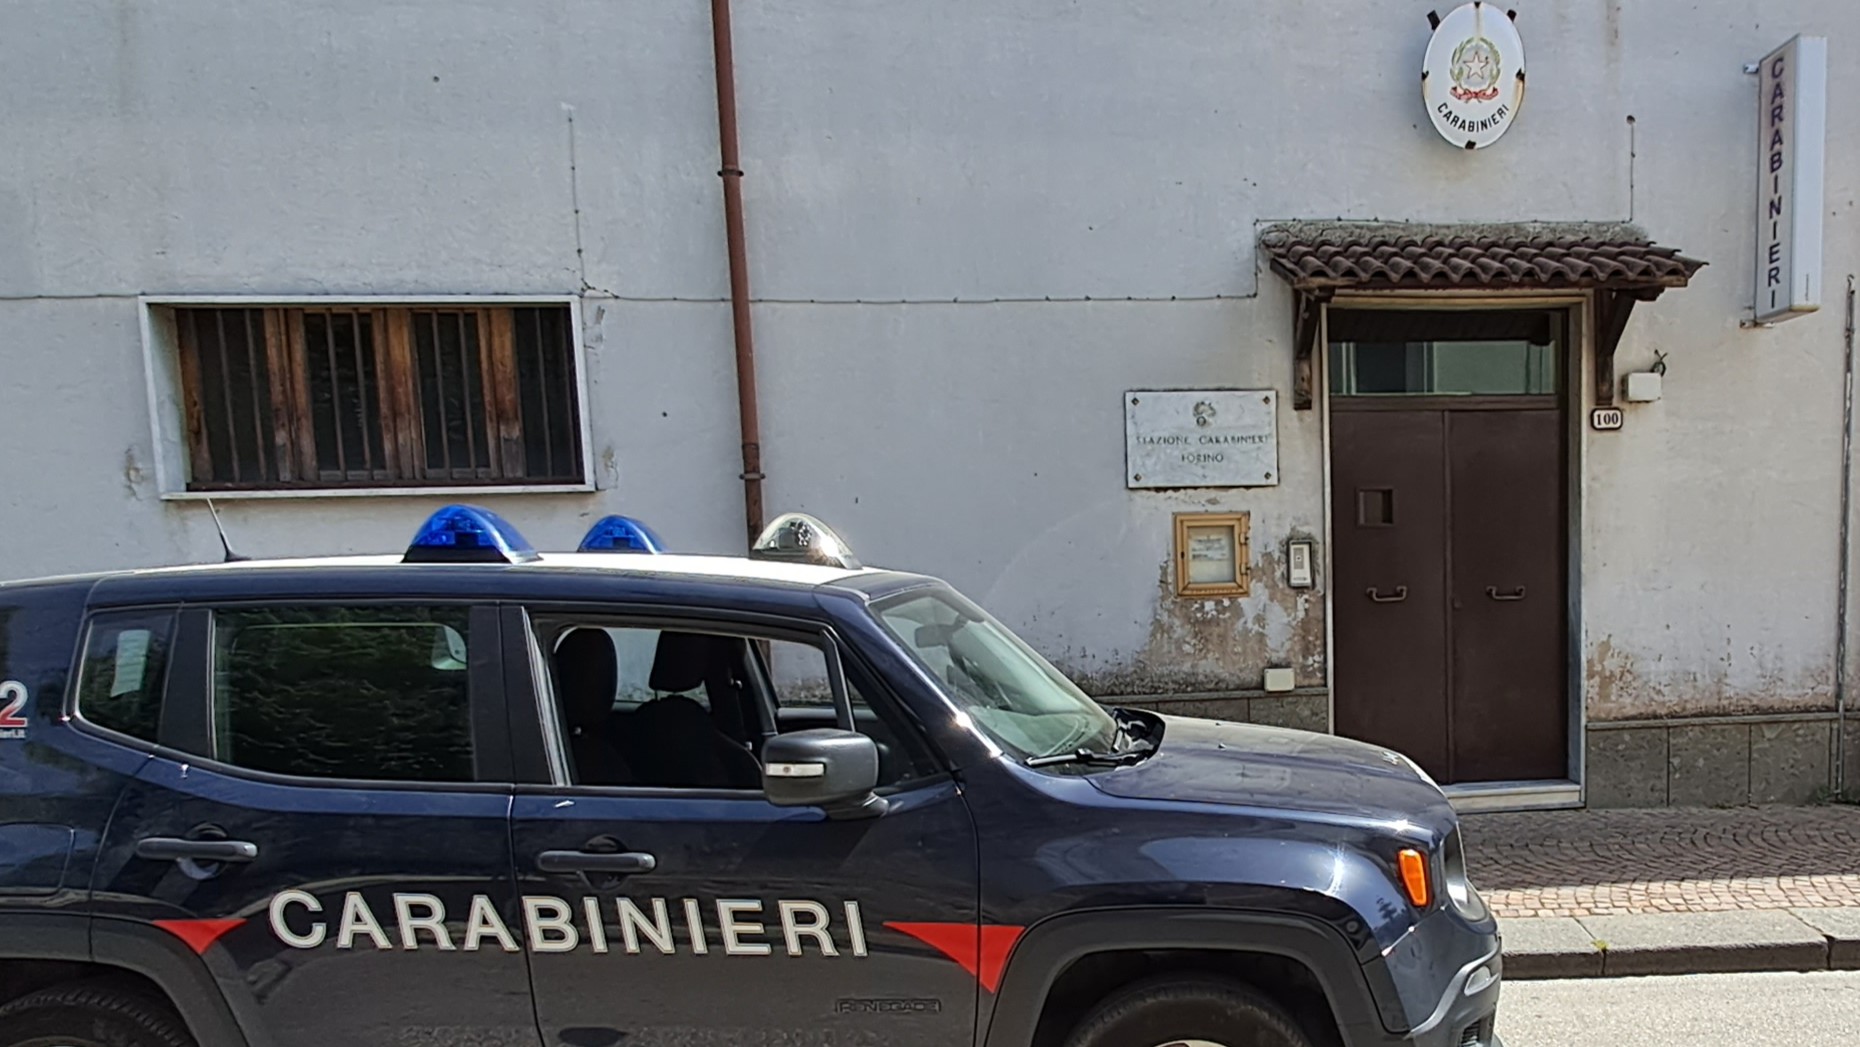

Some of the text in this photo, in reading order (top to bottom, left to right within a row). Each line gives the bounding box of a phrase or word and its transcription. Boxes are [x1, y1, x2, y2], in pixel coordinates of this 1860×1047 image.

[1437, 102, 1510, 133] CARABINIERI
[1768, 57, 1785, 309] CARABINIERI
[1596, 412, 1619, 426] 100
[269, 889, 869, 957] CARABINIERI
